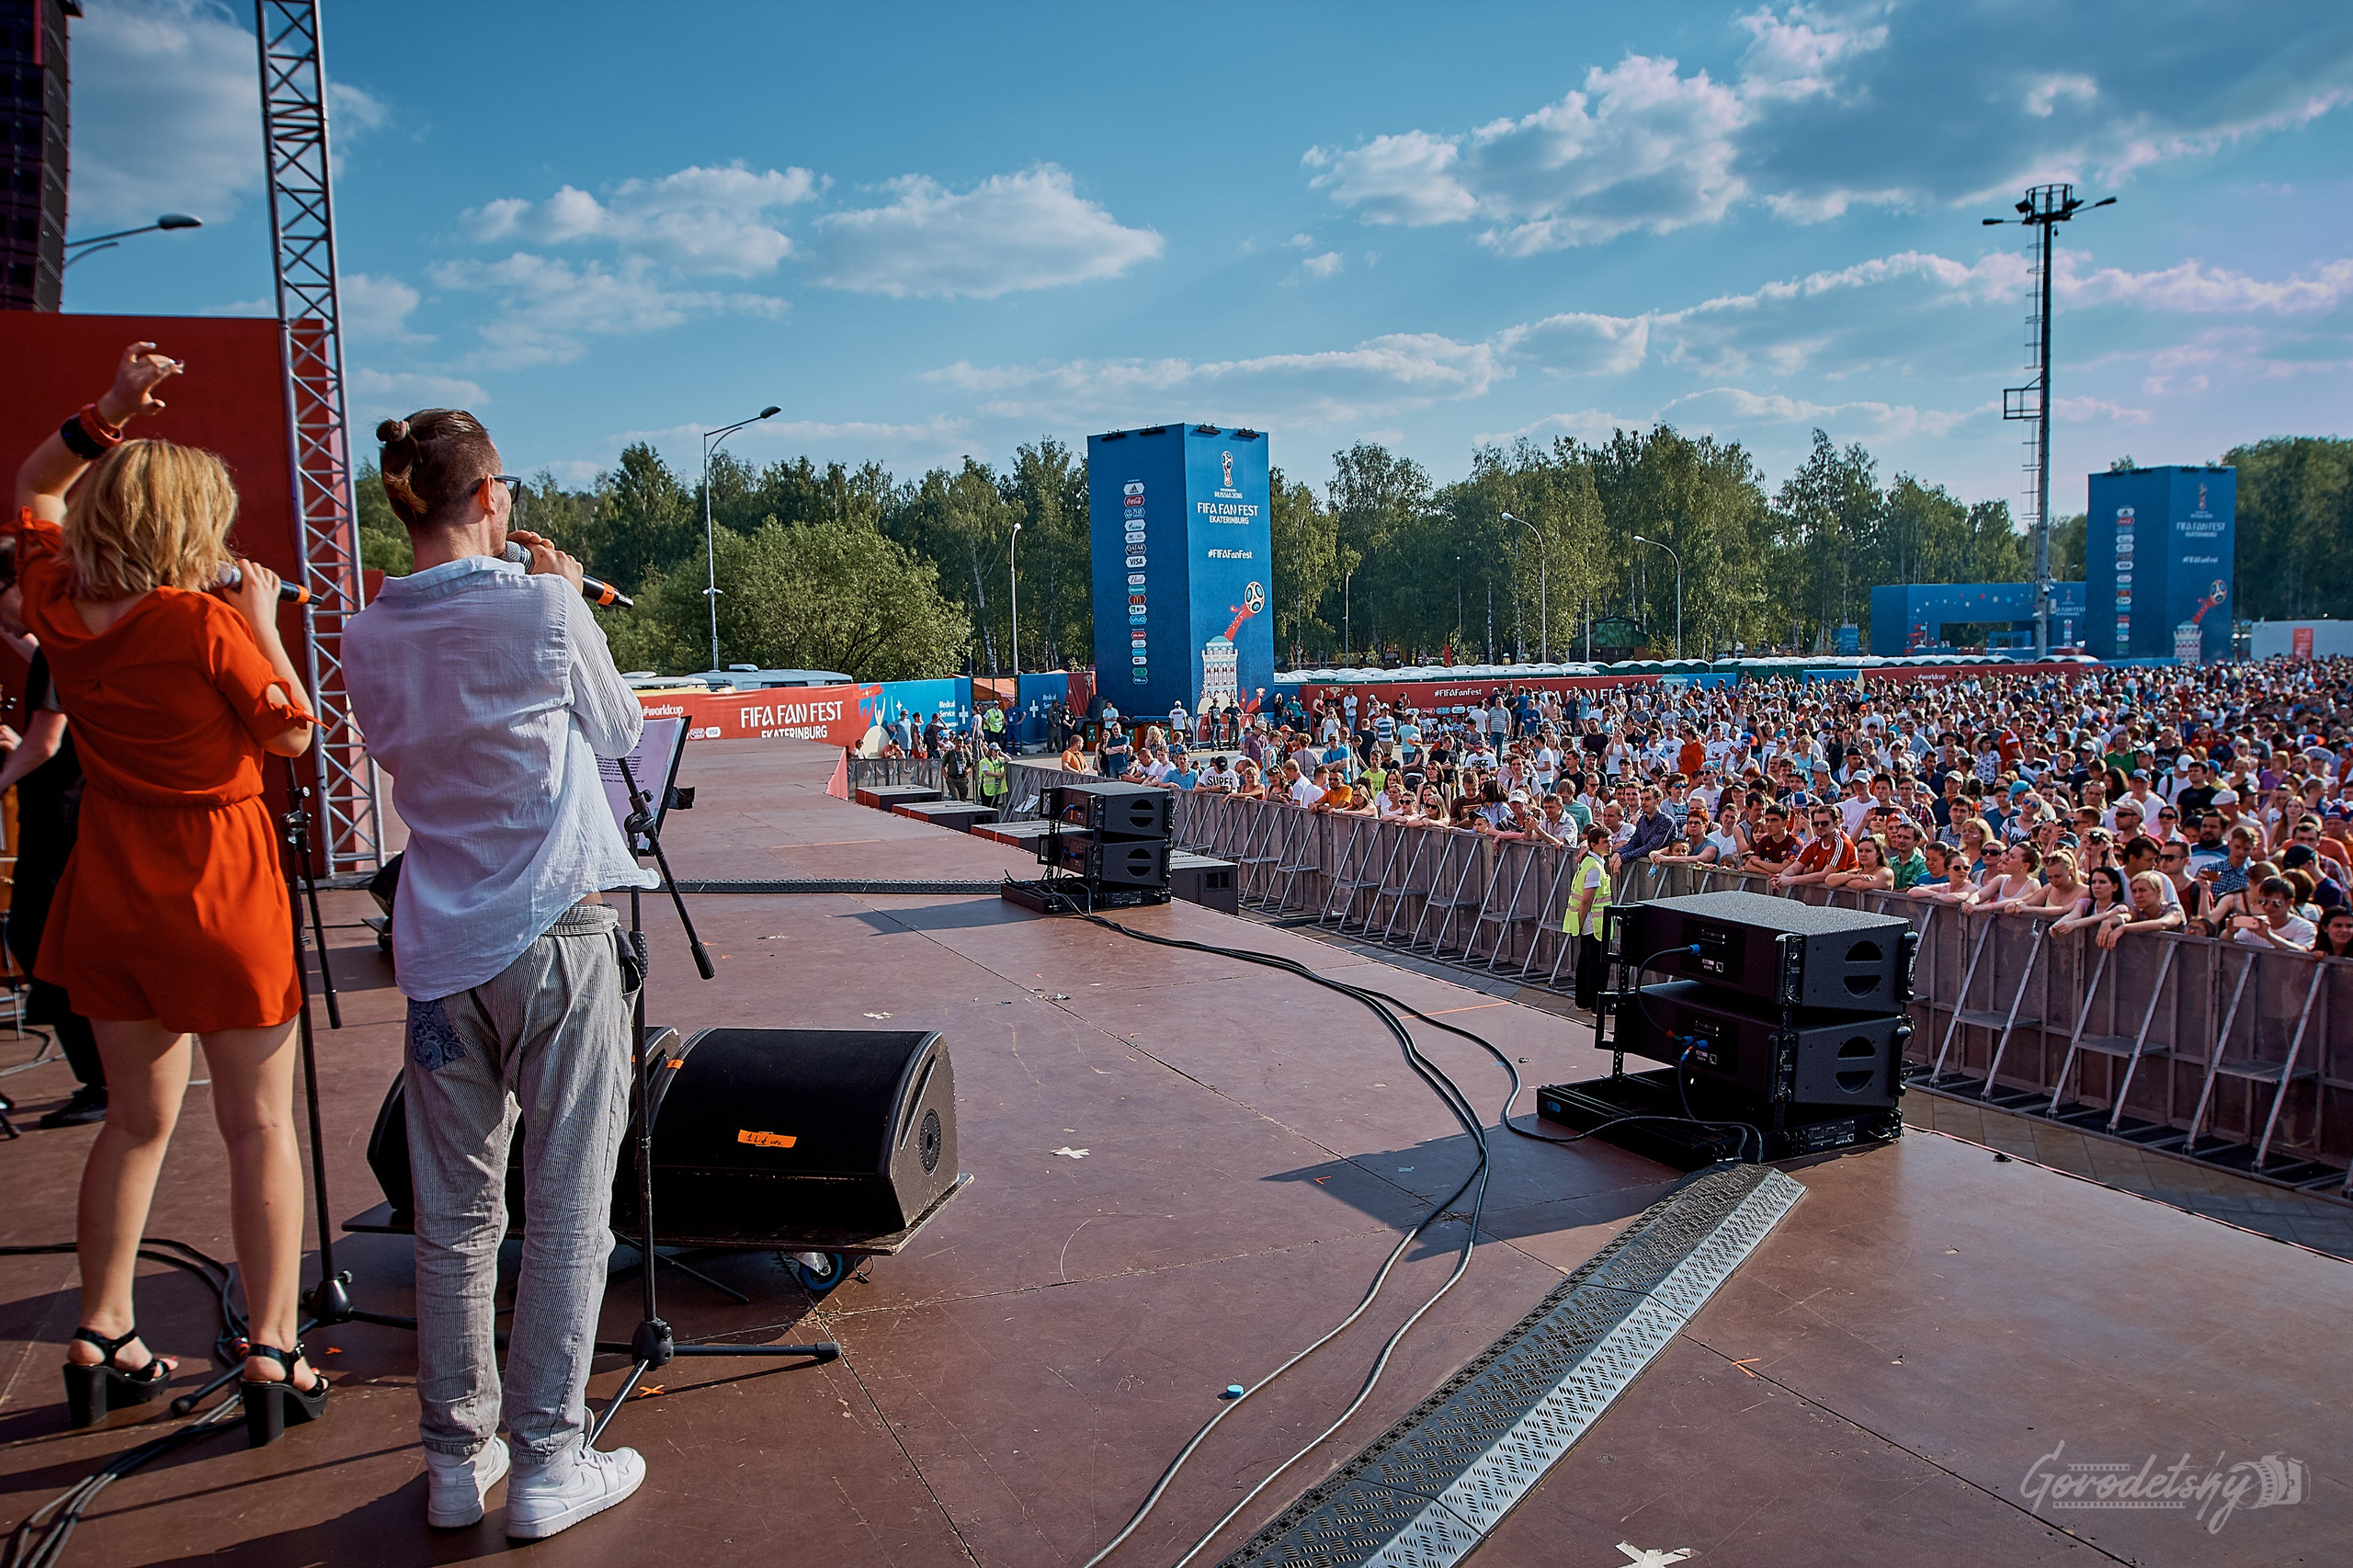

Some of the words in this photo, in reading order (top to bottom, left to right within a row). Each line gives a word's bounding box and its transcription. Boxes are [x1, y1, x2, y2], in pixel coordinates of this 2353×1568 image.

[1197, 502, 1217, 514] FIFA
[1218, 503, 1237, 515] FAN
[1238, 504, 1259, 516] FEST
[1209, 515, 1250, 524] EKATERINBURG
[2209, 522, 2226, 532] FEST
[1208, 549, 1253, 559] #FIFAFanFest
[1918, 673, 1947, 681] #worldcup
[1434, 688, 1482, 697] #FIFAFanFest
[939, 700, 955, 708] Medical
[642, 704, 683, 717] #worldcup
[741, 706, 775, 728] FIFA
[777, 704, 807, 725] FAN
[810, 701, 843, 722] FEST
